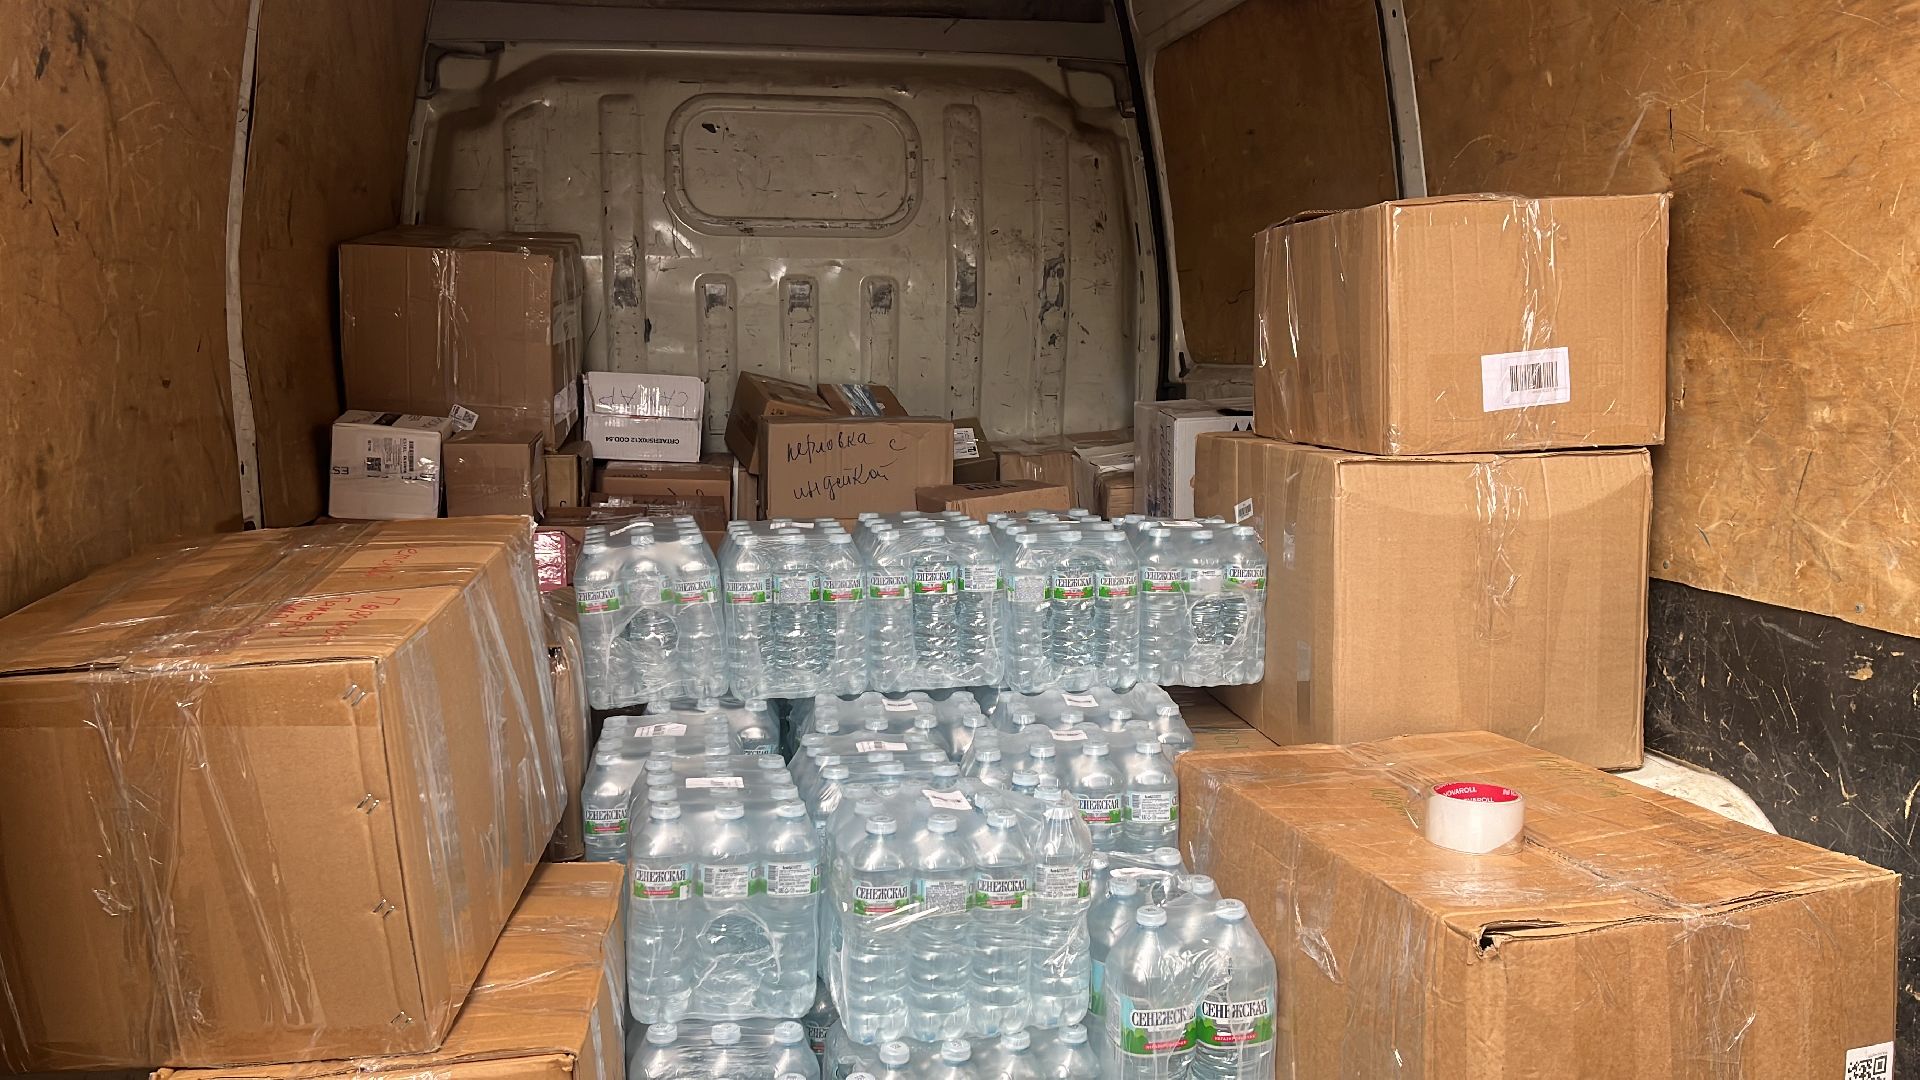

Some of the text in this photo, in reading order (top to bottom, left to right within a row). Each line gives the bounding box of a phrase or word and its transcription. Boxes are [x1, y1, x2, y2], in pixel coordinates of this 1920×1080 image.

[599, 386, 688, 407] СААР
[787, 431, 873, 463] перловка
[915, 571, 951, 582] СЕНЕЖСКАЯ
[1079, 799, 1119, 811] ЕНЕЖСКАЯ
[635, 869, 686, 883] СЕНЕЖСКАЯ
[856, 886, 907, 900] СЕНЕЖСКАЯ
[977, 880, 1027, 893] СЕНЕЖСКАЯ
[1131, 1003, 1196, 1027] СЕНЕЖСК
[1202, 1000, 1268, 1019] СЕНЕЖСКАЯ
